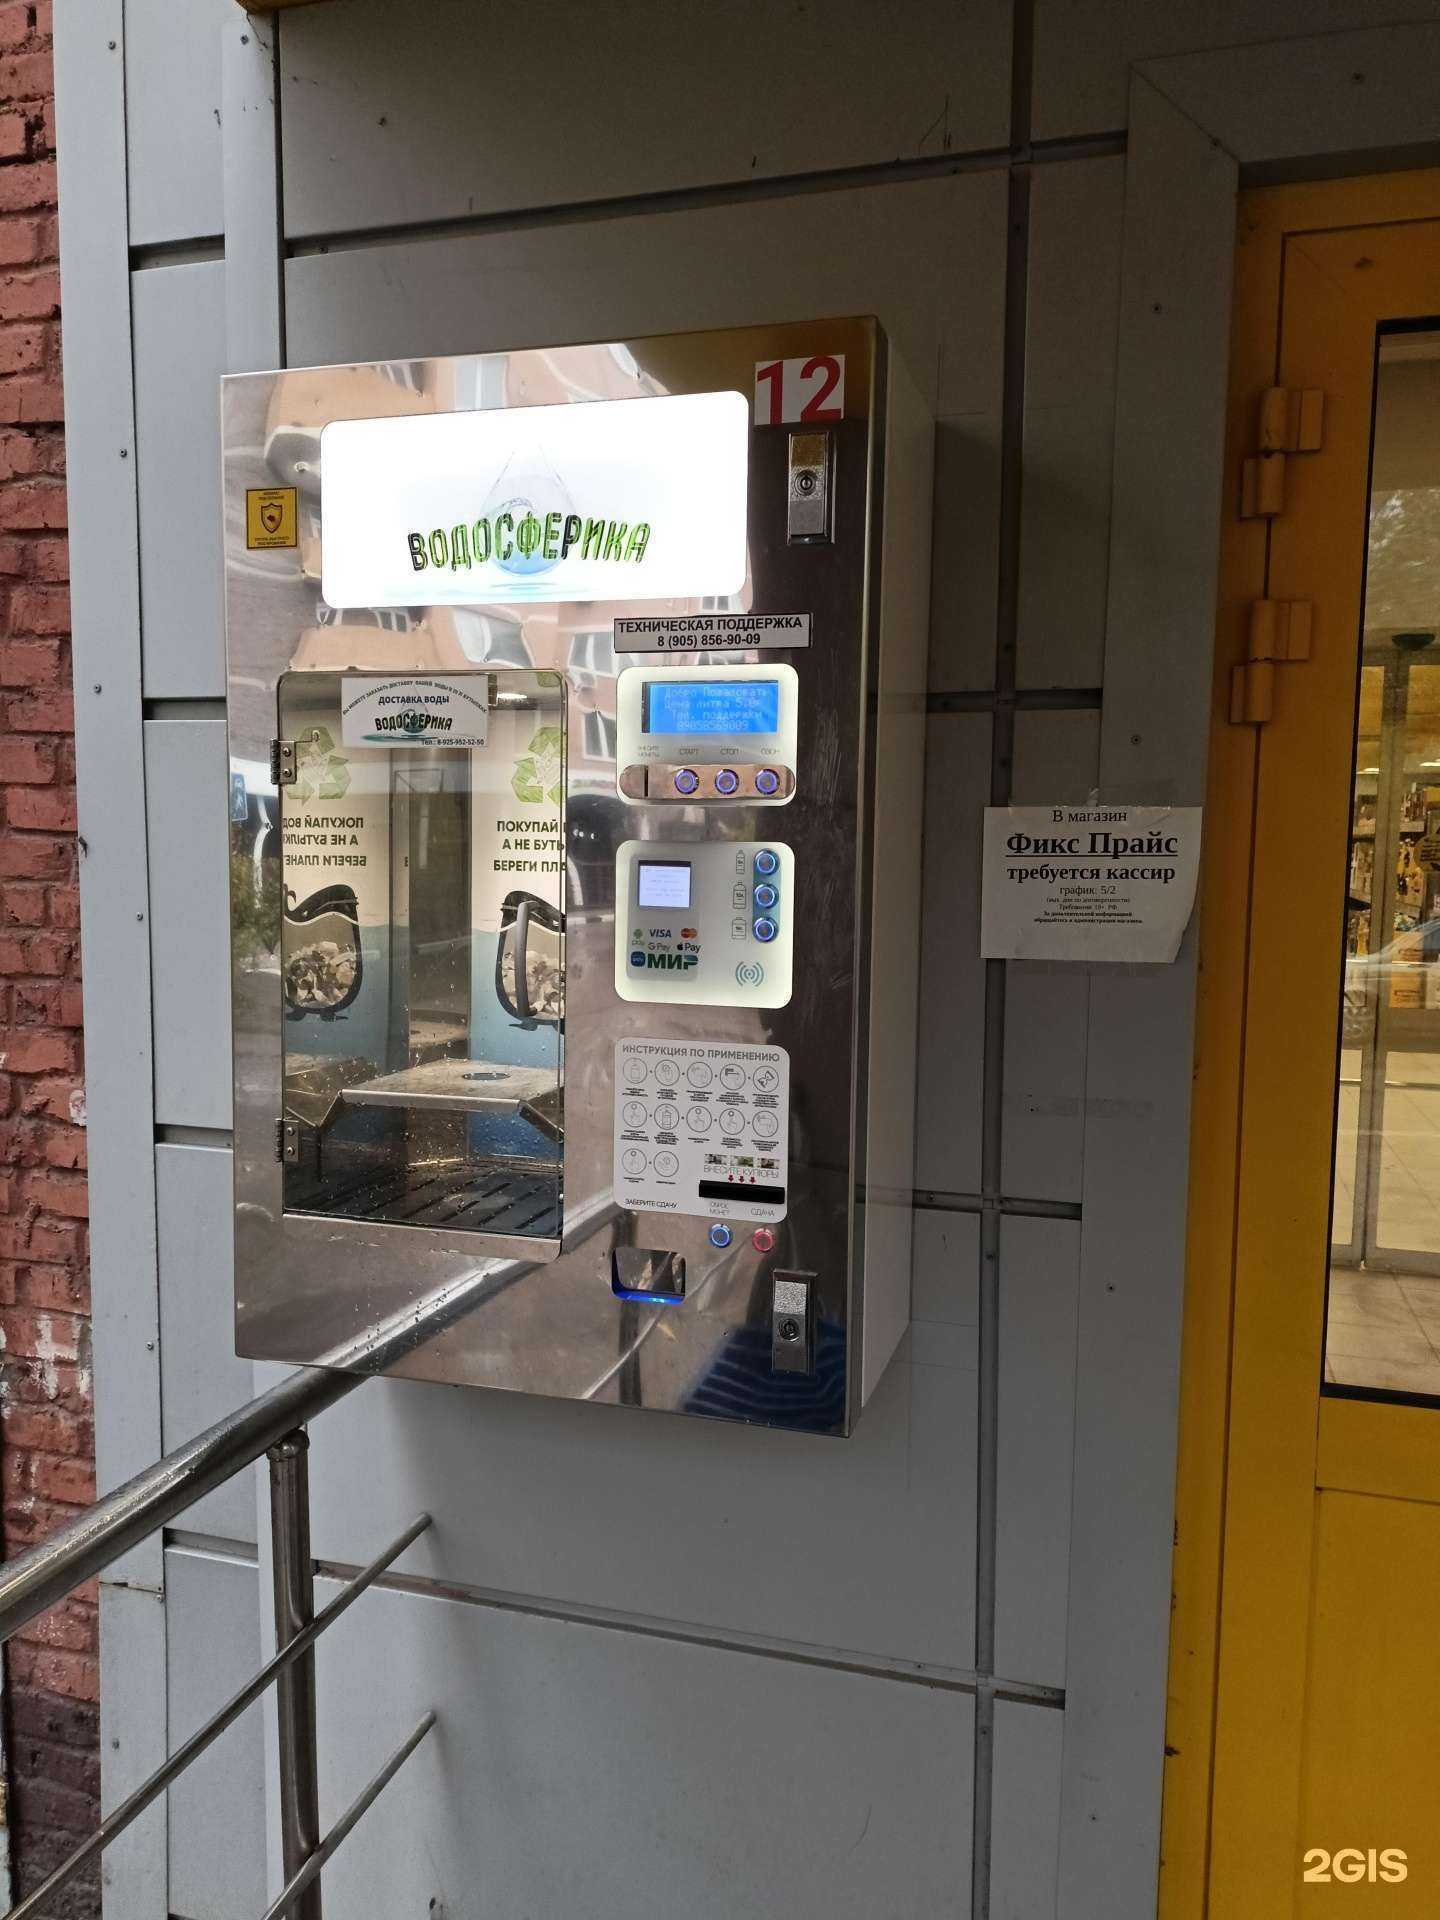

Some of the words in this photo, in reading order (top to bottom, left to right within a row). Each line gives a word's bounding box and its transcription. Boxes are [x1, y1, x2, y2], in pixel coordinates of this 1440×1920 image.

[757, 355, 841, 425] 12
[407, 511, 650, 571] ВОДОСФЕРИКА
[618, 619, 713, 633] ТЕХНИЧЕСКАЯ
[717, 617, 802, 632] ПОДДЕРЖКА
[657, 636, 665, 647] 8
[668, 635, 697, 649] (905)
[701, 633, 761, 646] 856-90-09
[378, 696, 422, 705] ДОСТАВКА
[424, 695, 450, 705] ВОДЫ
[375, 713, 453, 731] ВОДОСФЕРИКА
[1052, 810, 1064, 823] В
[1068, 812, 1127, 822] магазин
[497, 818, 558, 833] ПОКУПАЙ
[502, 838, 512, 850] А
[514, 839, 530, 850] НЕ
[1006, 832, 1080, 854] Фикс
[1087, 831, 1178, 859] Прайс
[493, 859, 538, 872] БЕРЕГИ
[1006, 864, 1100, 883] требуется
[1106, 867, 1176, 883] кассир
[1100, 886, 1116, 895] 5/2
[649, 928, 672, 938] VISA
[685, 943, 701, 954] Pay
[647, 953, 699, 970] МИР
[622, 1045, 688, 1058] ИНСТРУКЦИЯ
[690, 1049, 705, 1058] ПО
[707, 1050, 780, 1062] ПРИМЕНЕНИЮ
[703, 1165, 741, 1176] ВНЕСИТЕ
[742, 1168, 780, 1179] КУПЮРЫ
[625, 1199, 656, 1208] ЗАБЕРИТЕ
[656, 1201, 678, 1209] СДАЧУ
[750, 1208, 775, 1217] СДАЧА
